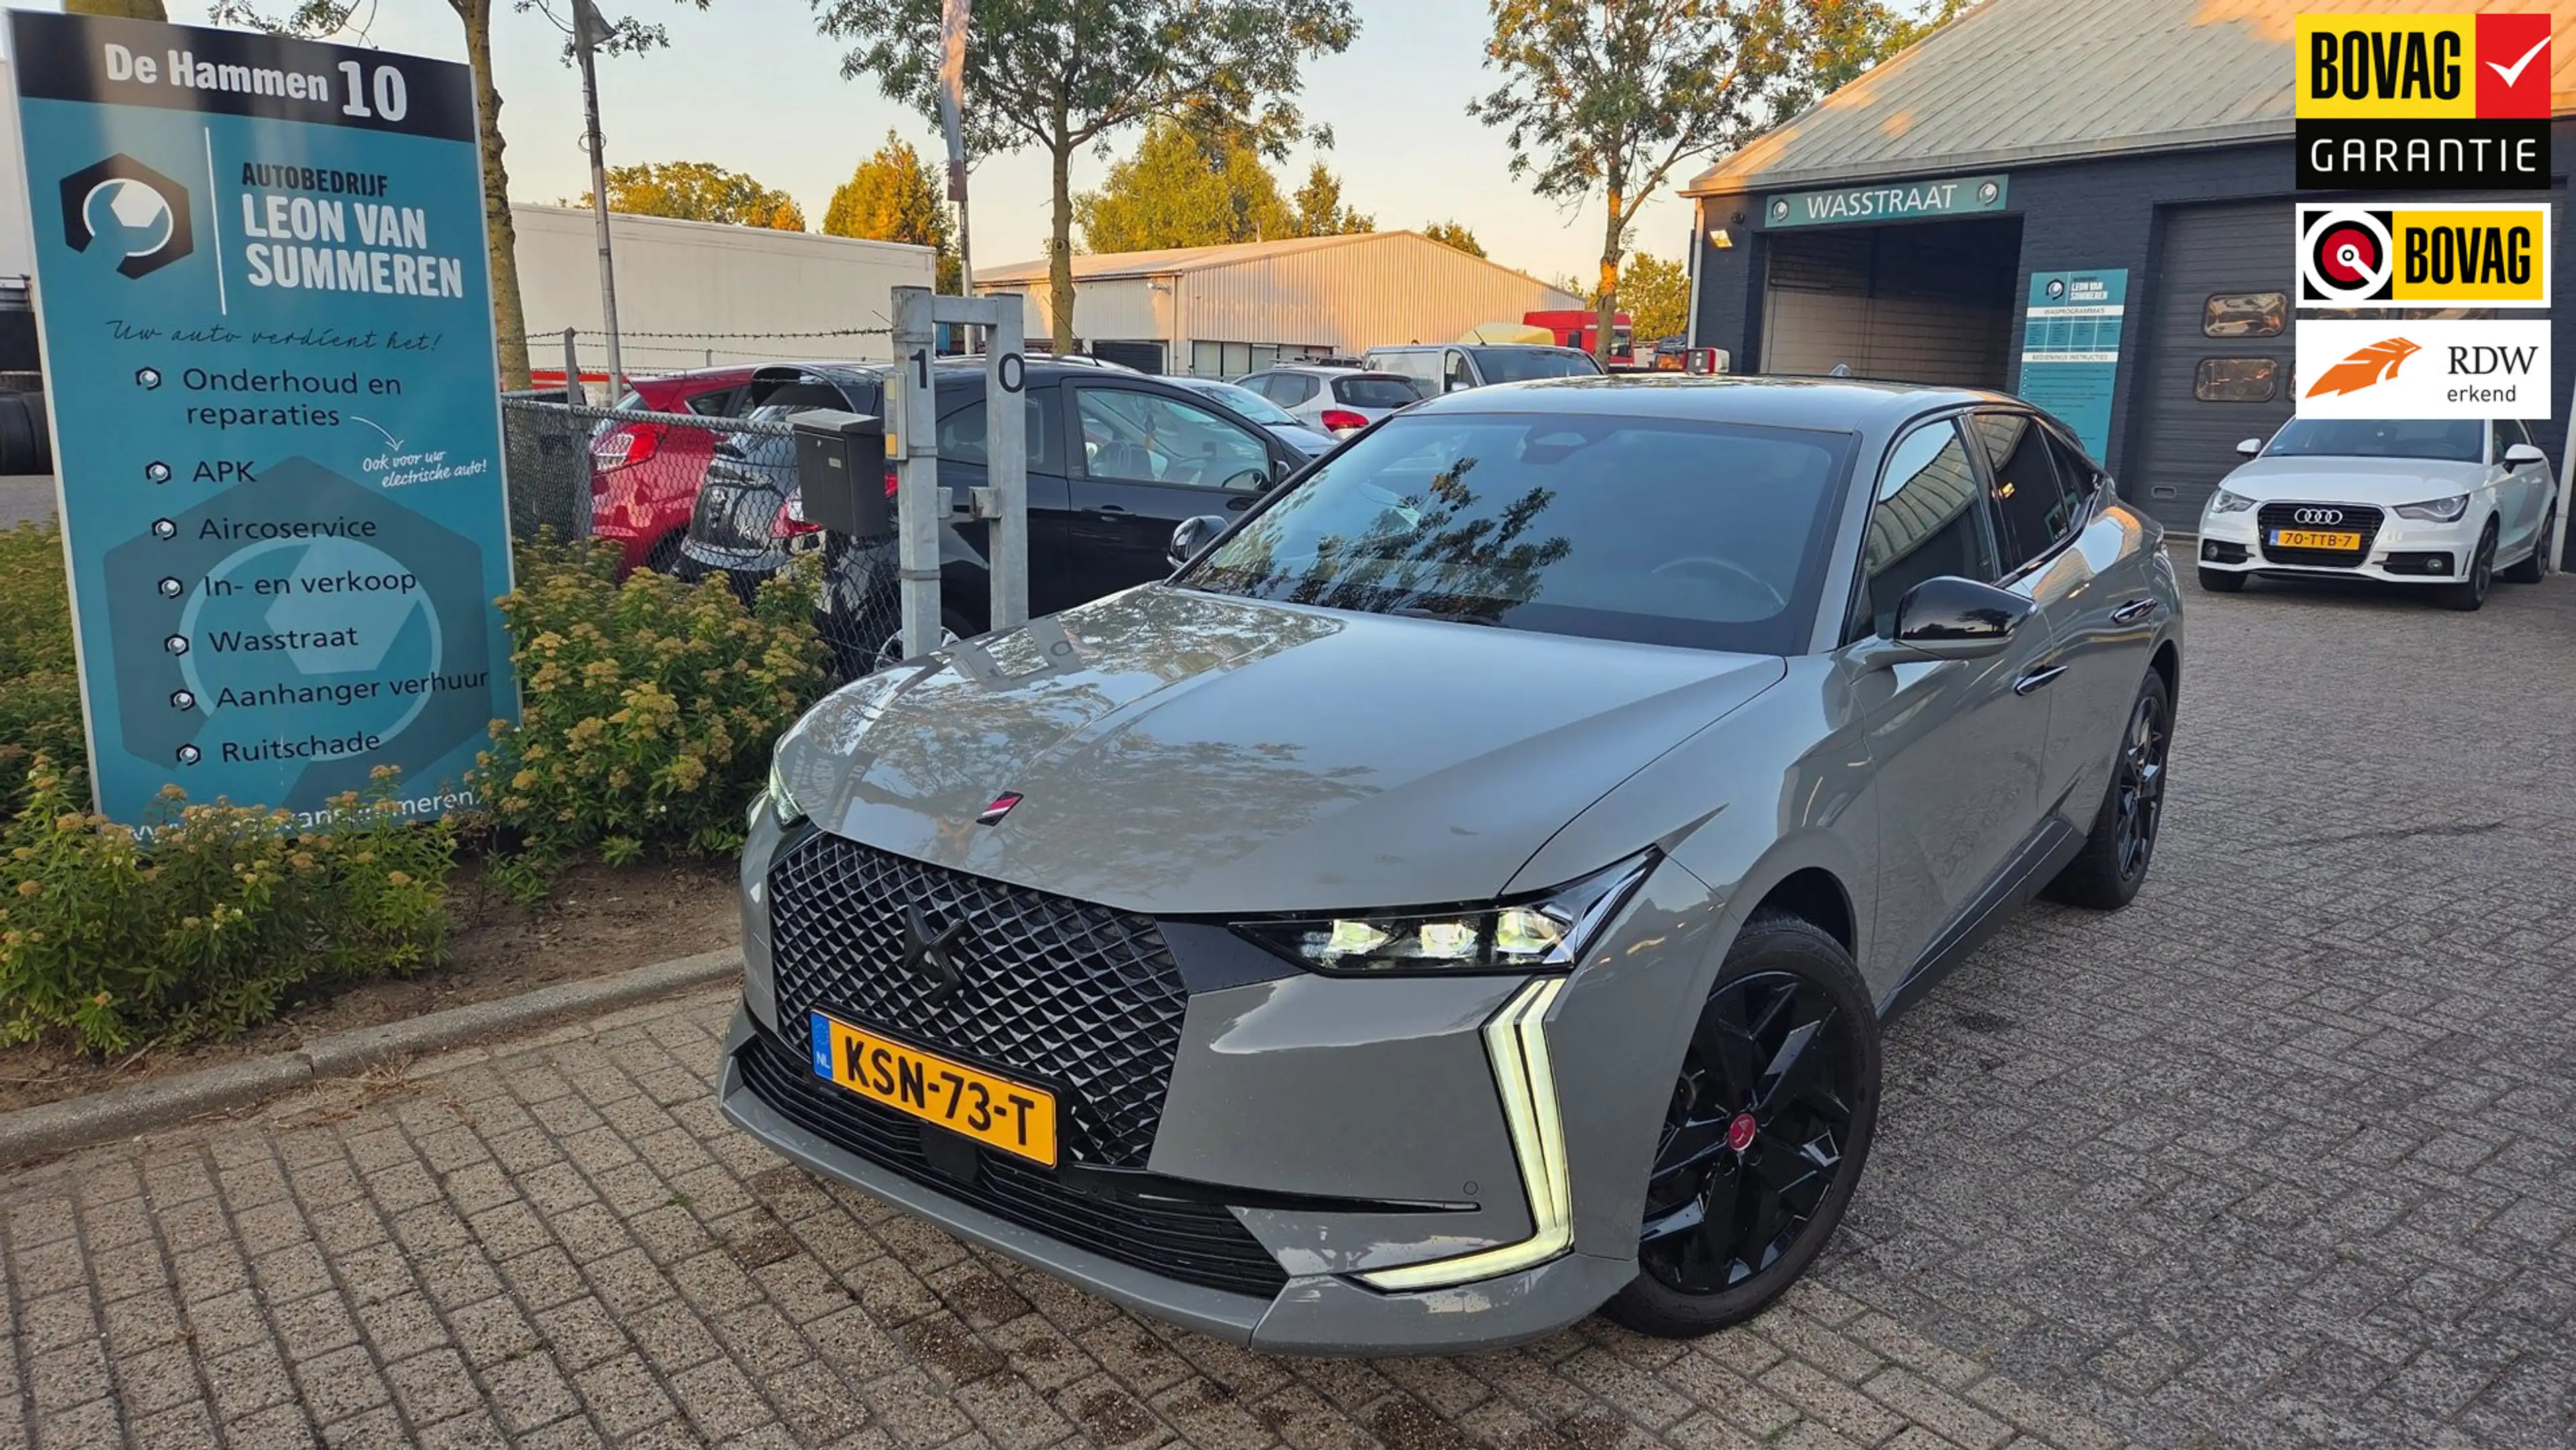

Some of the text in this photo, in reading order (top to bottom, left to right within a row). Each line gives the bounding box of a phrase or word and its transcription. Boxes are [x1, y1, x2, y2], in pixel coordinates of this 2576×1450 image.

[105, 43, 408, 123] De Hammen 10
[242, 162, 388, 198] AUTOBEDRIJF
[1807, 185, 1957, 219] WASSTRAAT
[242, 193, 427, 250] LEON VAN
[246, 244, 464, 299] SUMMEREN
[105, 320, 442, 352] Uw auto verdient het!
[182, 368, 402, 396] Onderhoud en
[186, 404, 340, 431] reparaties
[192, 462, 257, 482] APK
[362, 452, 446, 472] Ook voor uw
[382, 460, 487, 488] electrische auto!
[198, 518, 377, 539] Aircoservice
[2284, 533, 2353, 547] 70-TTB-7
[204, 572, 417, 597] In- en verkoop
[208, 627, 358, 652] Wasstraat
[215, 671, 488, 708] Aanhanger verhuur
[221, 733, 380, 762] Ruitschade
[816, 1036, 1034, 1145] NL KSN-73-T
